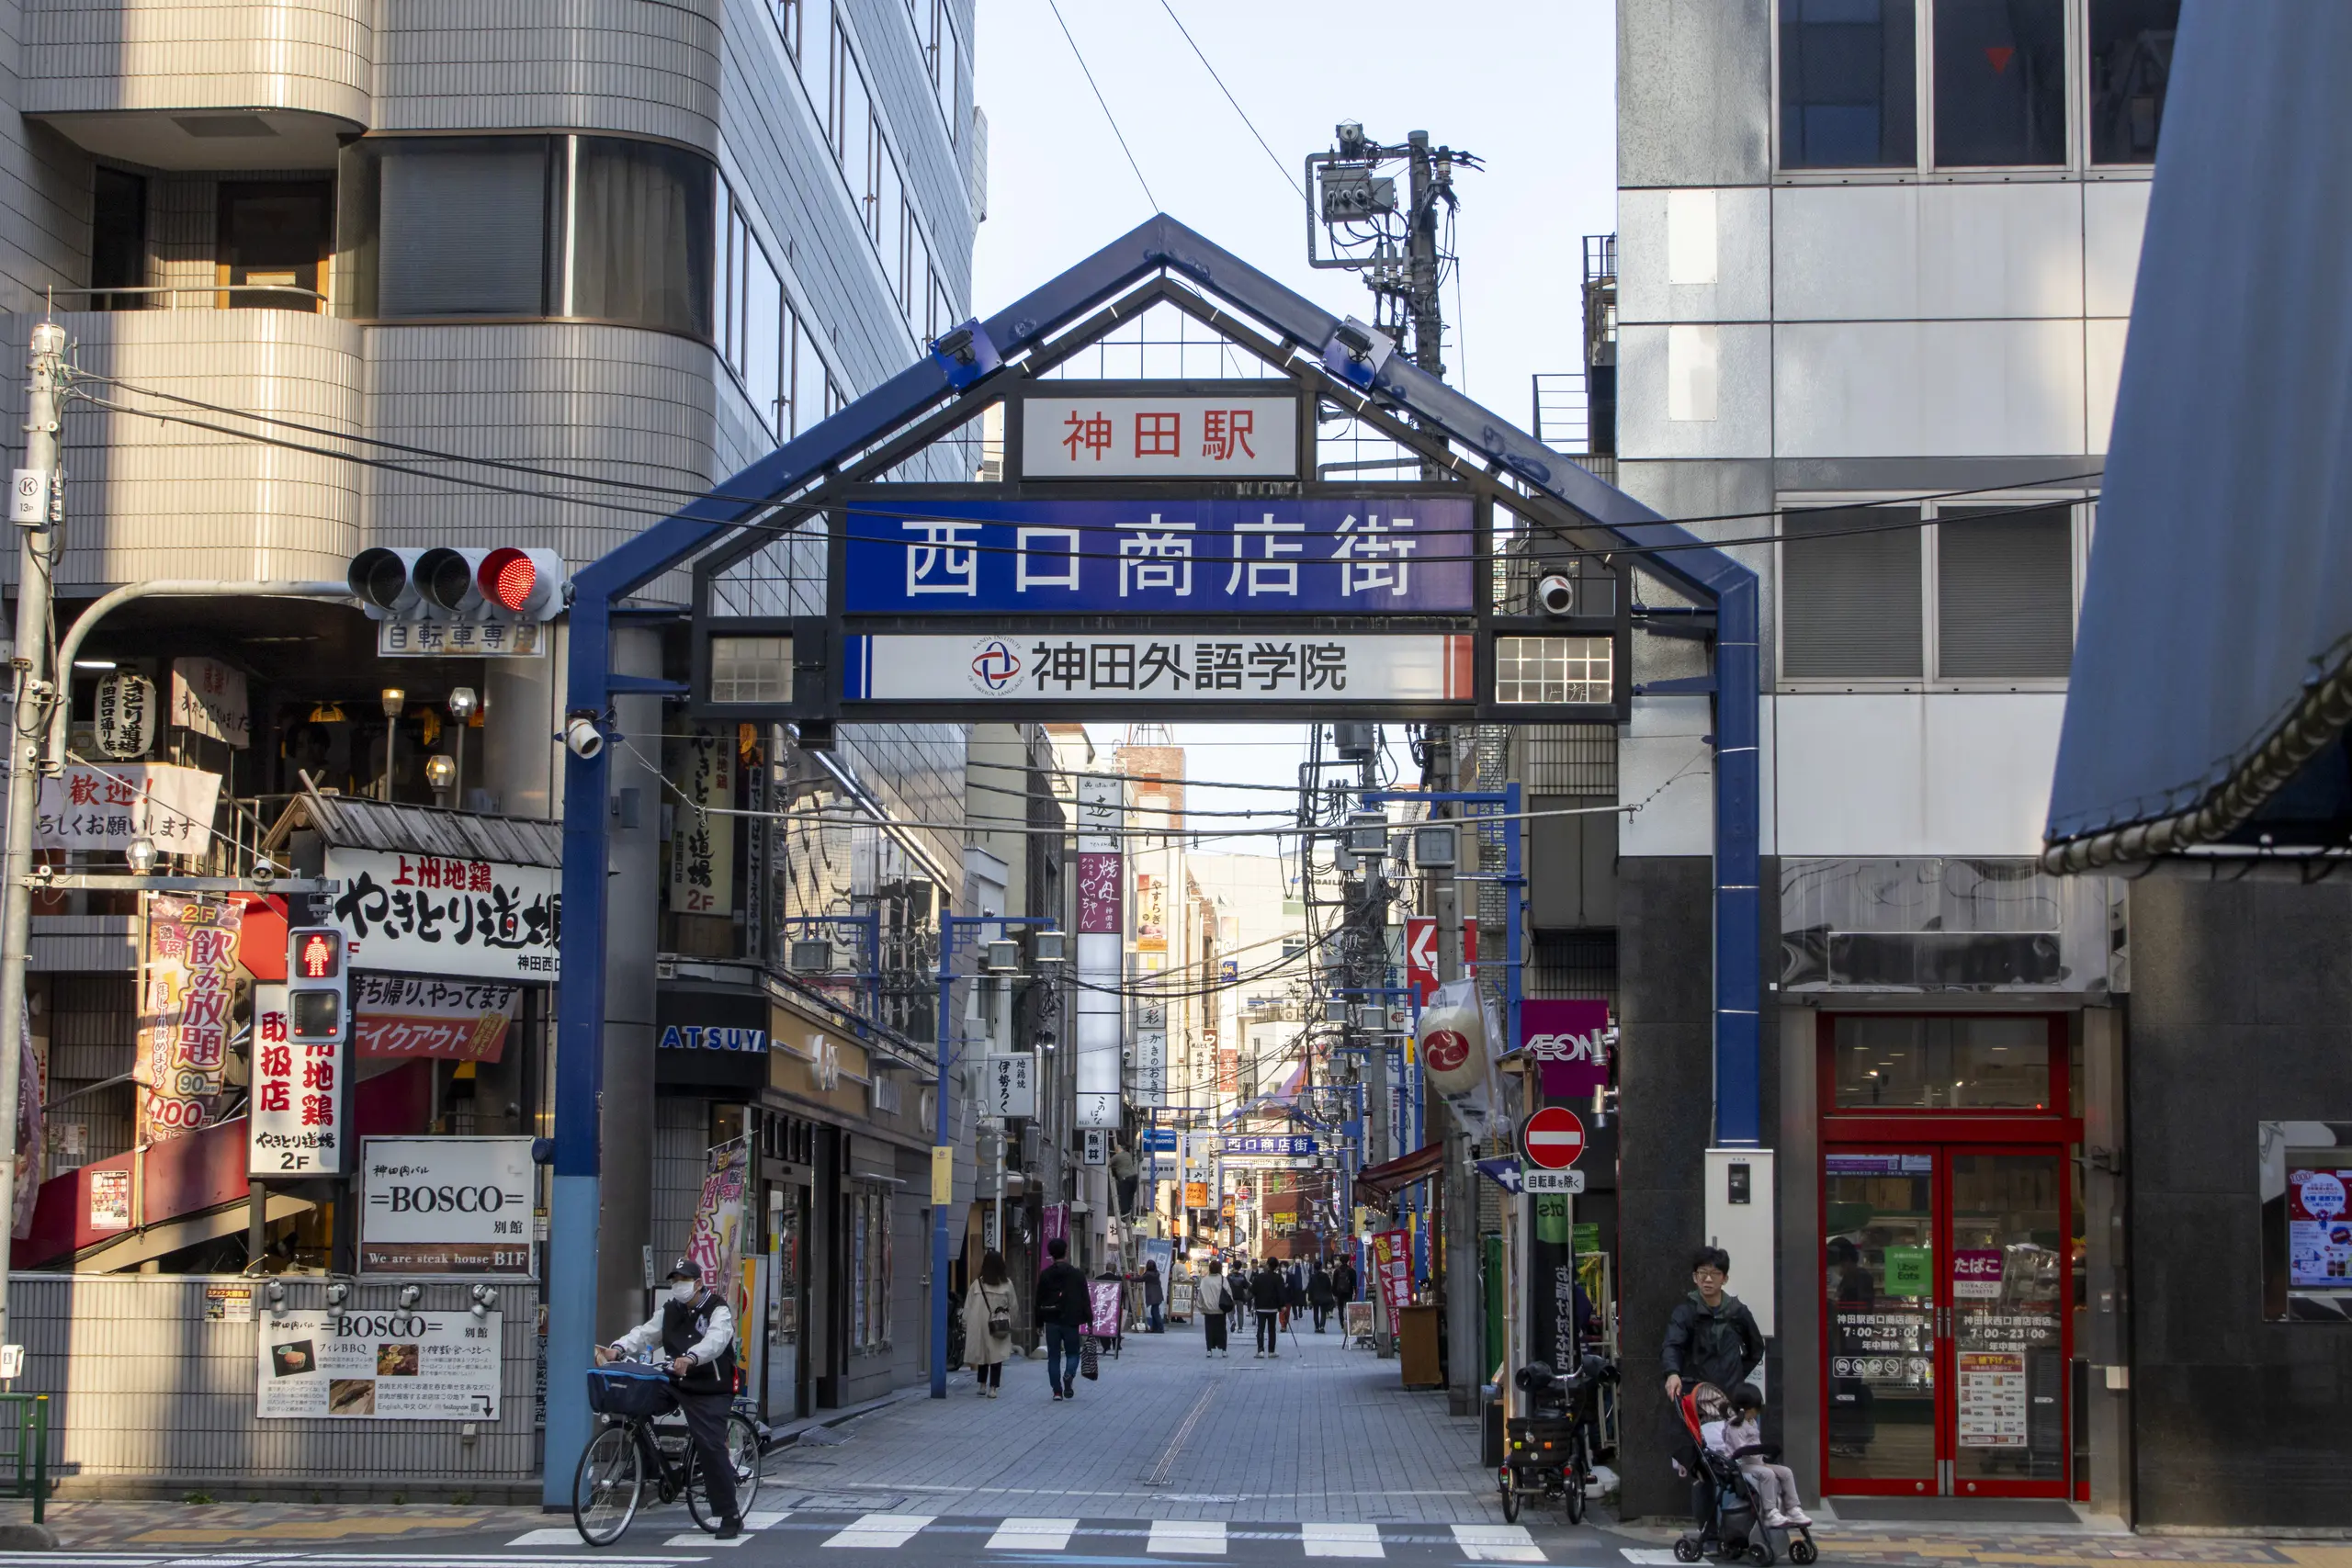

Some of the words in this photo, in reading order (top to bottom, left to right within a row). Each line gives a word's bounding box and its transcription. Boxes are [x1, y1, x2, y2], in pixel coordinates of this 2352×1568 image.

[1062, 409, 1257, 462] 神田駅
[901, 513, 1417, 597] 西口商店街
[390, 622, 537, 649] 自転車専用
[972, 636, 992, 650] KANDA
[1031, 640, 1348, 692] 神田外語学院
[69, 773, 154, 807] 歓迎!
[390, 855, 492, 894] 上州地鶏
[687, 889, 715, 911] 2F
[1151, 879, 1162, 925] やすらぎ
[181, 905, 217, 923] 2F
[176, 929, 234, 1066] 飲み放題
[260, 1010, 292, 1112] 取扱店
[1148, 1033, 1161, 1103] かきのおきて
[1016, 1058, 1026, 1089] 地鶏焼
[998, 1060, 1012, 1113] 伊勢ろく
[255, 1132, 335, 1149] やきとり道場
[1227, 1137, 1308, 1152] 西口商店街
[280, 1151, 311, 1171] 2F
[1528, 1175, 1579, 1188] 自転車を除く
[492, 1220, 524, 1235] 別館
[368, 1253, 387, 1264] We
[391, 1255, 412, 1264] are
[417, 1252, 449, 1264] steak
[454, 1253, 489, 1264] house
[492, 1251, 527, 1266] B1F
[1897, 1262, 1919, 1271] Uber
[1954, 1257, 2000, 1274] たばこ
[1897, 1272, 1920, 1280] Eats
[1837, 1314, 1925, 1325] 神田駅西口商店街店
[1963, 1315, 2052, 1326] 神田駅西口商店街店
[464, 1326, 489, 1338] 別館
[1861, 1340, 1900, 1350] 年中無休
[1988, 1341, 2027, 1351] 年中無休
